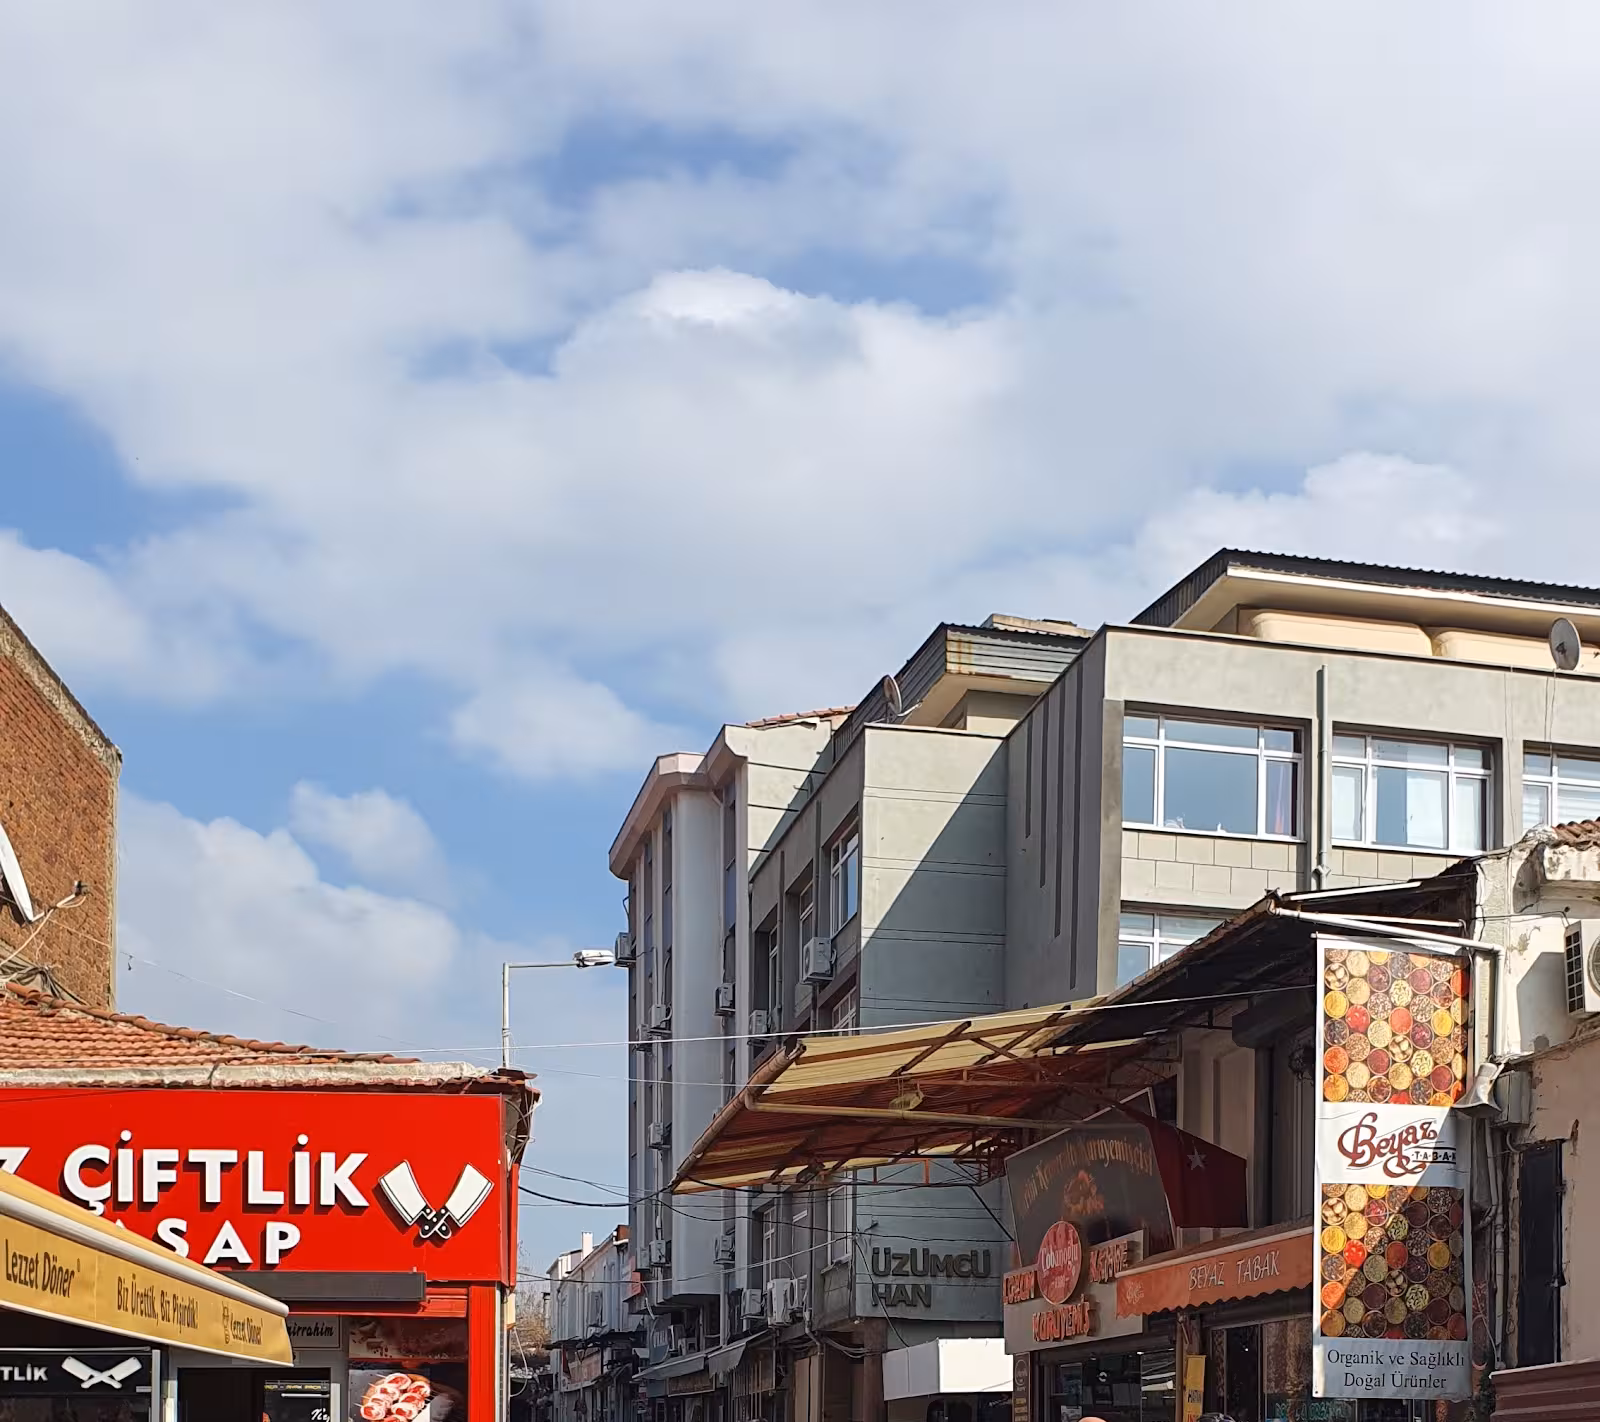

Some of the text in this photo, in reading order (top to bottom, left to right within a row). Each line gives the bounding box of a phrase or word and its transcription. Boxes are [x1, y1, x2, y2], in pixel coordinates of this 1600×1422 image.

[1337, 1112, 1438, 1178] Beyaz
[63, 1130, 370, 1218] ÇİFTLİK
[115, 1218, 301, 1265] SAP
[5, 1239, 76, 1298] Lezzet Döner
[1188, 1250, 1280, 1291] BEYAZ TABAK
[117, 1276, 129, 1312] Biz
[160, 1285, 171, 1323] Biz
[871, 1283, 932, 1308] HAN
[1327, 1349, 1464, 1370] Organik ve Sağlıklı
[1344, 1371, 1447, 1390] Doğal Ürünler
